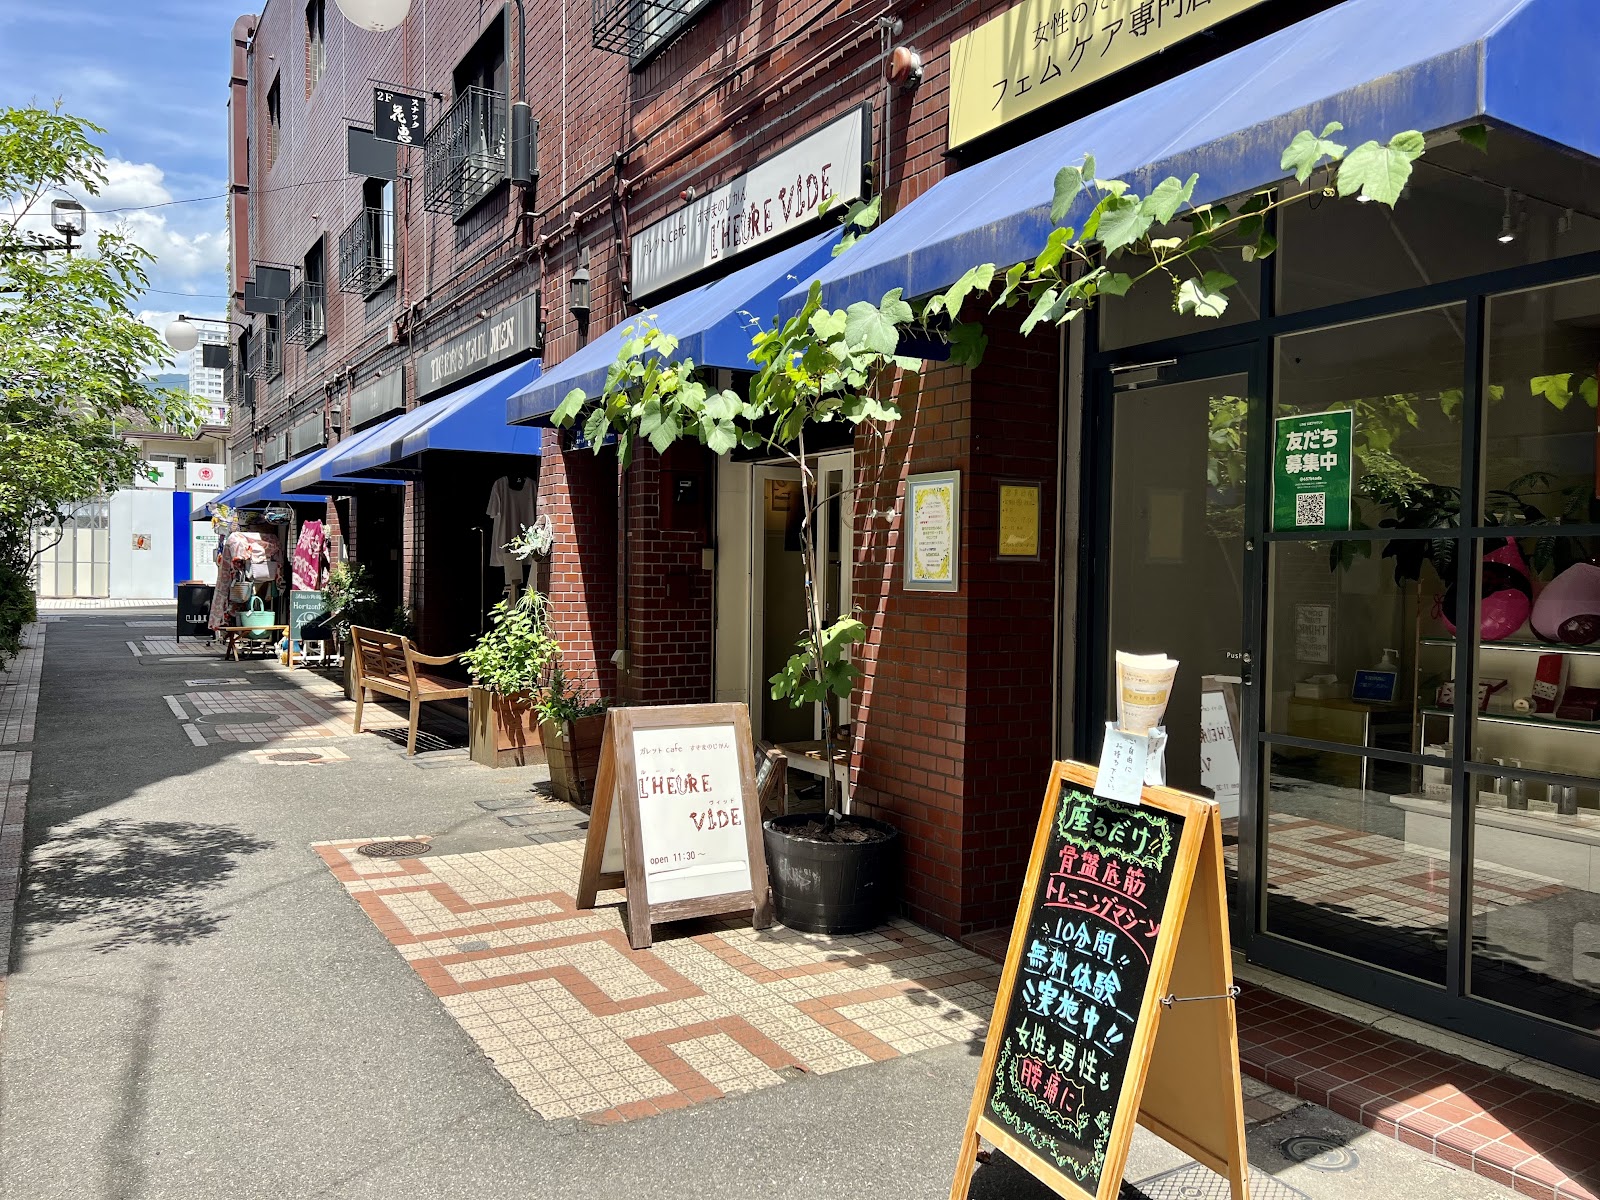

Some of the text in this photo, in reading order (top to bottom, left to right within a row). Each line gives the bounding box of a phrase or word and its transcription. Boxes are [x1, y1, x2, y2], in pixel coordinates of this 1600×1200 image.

[991, 0, 1211, 111] フェムケア専門
[376, 91, 394, 103] 2F
[410, 99, 420, 129] スナック
[710, 162, 833, 260] L'HEURE VIDE
[668, 215, 687, 243] cafe
[430, 344, 464, 383] TIGER'S
[1285, 428, 1338, 452] 友だち
[1285, 451, 1338, 474] 募集中
[639, 746, 663, 756] ガレット
[665, 742, 683, 754] cafe
[638, 773, 713, 799] L'HEURE
[689, 807, 743, 832] VIDE
[650, 853, 669, 866] open
[1058, 844, 1147, 899] 骨盤底筋
[1045, 876, 1161, 938] トレーニングマシーン
[1026, 939, 1122, 1008] 無料体験
[1015, 1017, 1110, 1092] 女性も男性も
[1020, 1058, 1076, 1114] 腰痛に
